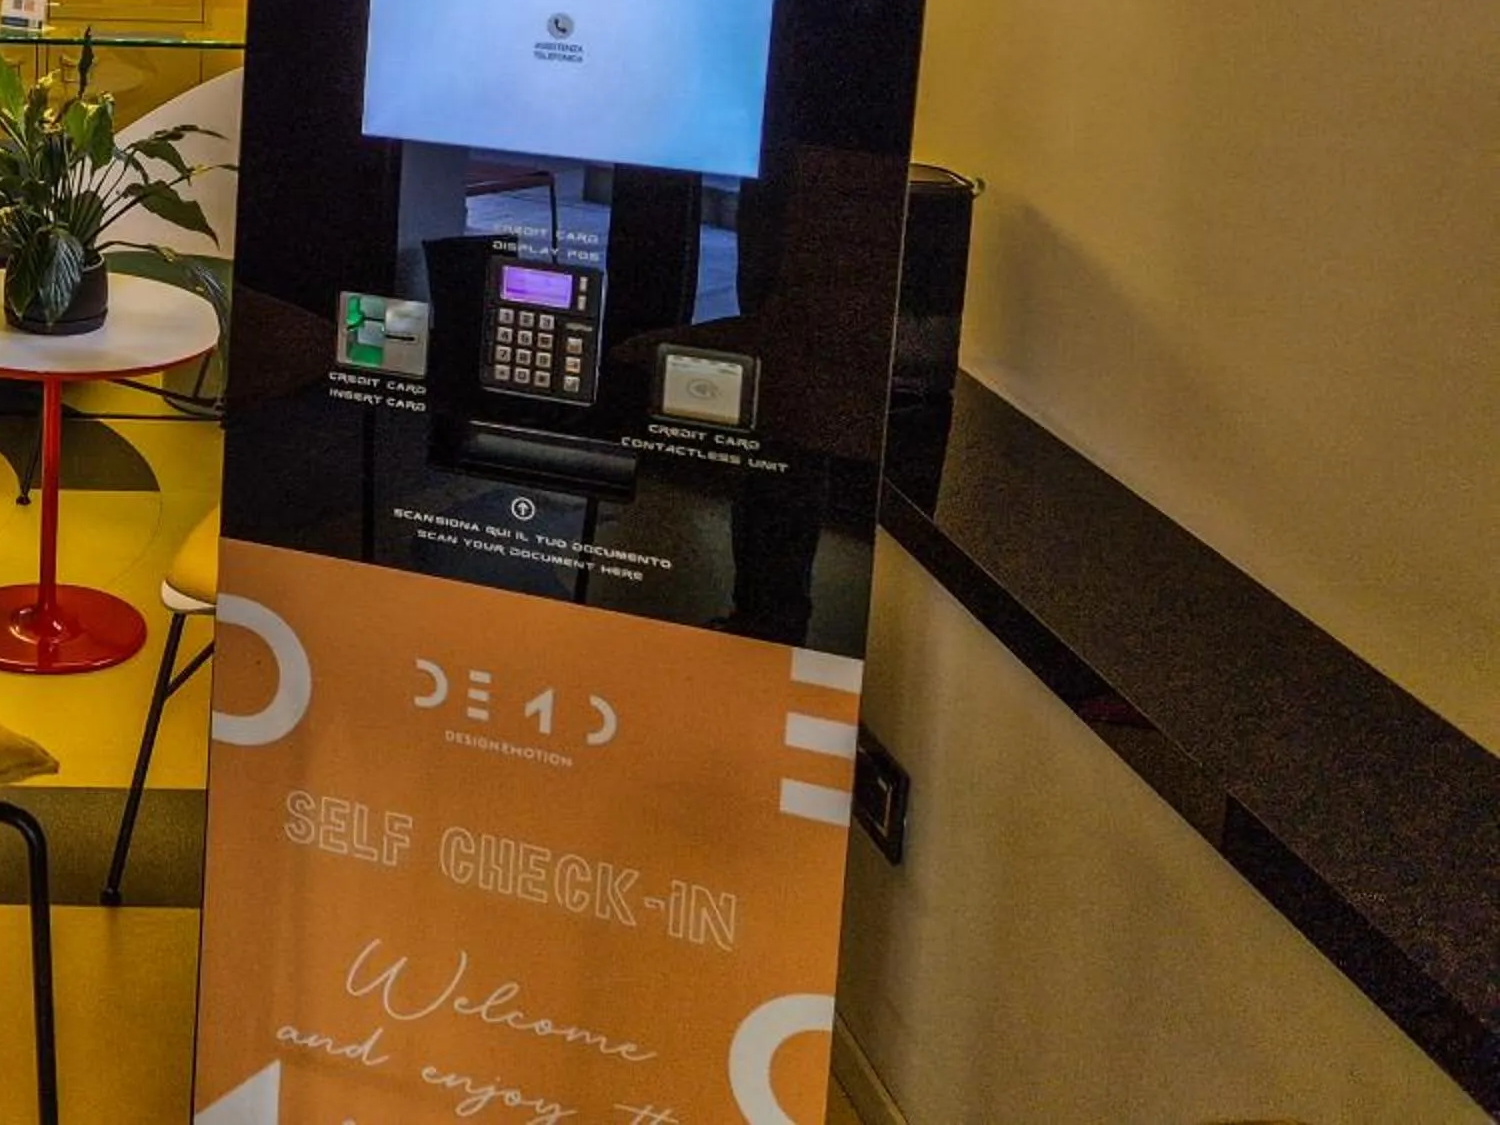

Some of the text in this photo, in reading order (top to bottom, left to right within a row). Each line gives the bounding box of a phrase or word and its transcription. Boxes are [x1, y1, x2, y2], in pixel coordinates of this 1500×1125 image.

[492, 240, 599, 262] DISPLAY POS
[556, 230, 598, 244] CARD
[329, 371, 427, 395] CREDIT CARD
[329, 388, 426, 412] INSERT CARD
[621, 436, 789, 474] CONTACTLESS UNIT
[648, 424, 760, 451] CREDIT CARD
[393, 507, 480, 533] SCANSIONA
[486, 525, 511, 538] QUI
[535, 534, 567, 549] TUO
[572, 542, 672, 570] DOCUMENTO
[417, 529, 644, 581] SCAN YOUR DOCUMENT HERE
[284, 789, 737, 952] SELF CHECK-IN
[344, 937, 658, 1063] Welcome
[276, 1026, 390, 1067] and
[420, 1063, 579, 1117] enjoy
